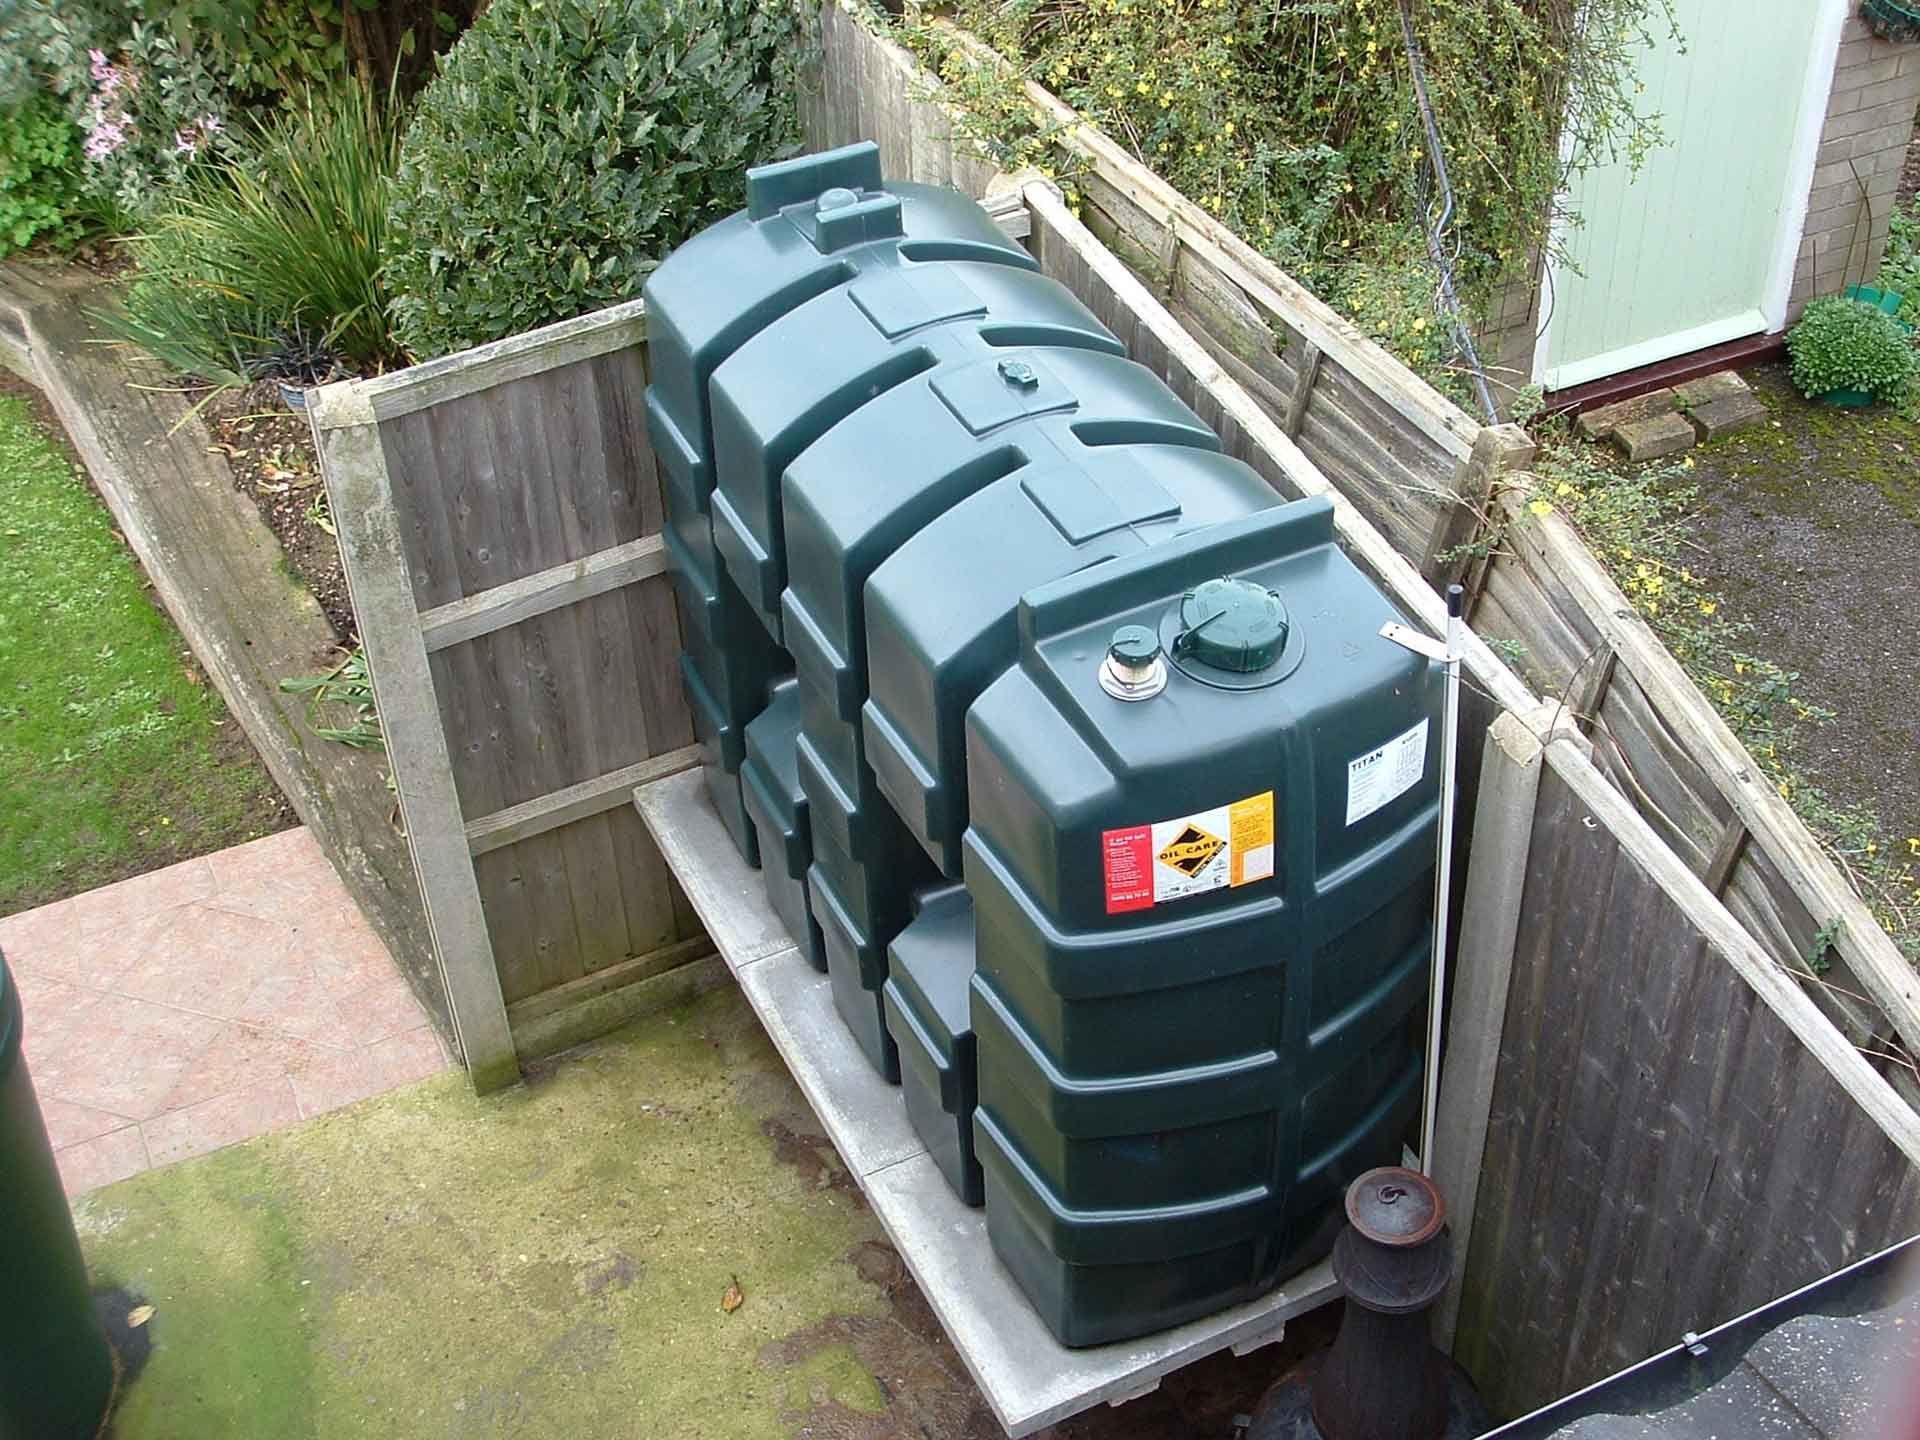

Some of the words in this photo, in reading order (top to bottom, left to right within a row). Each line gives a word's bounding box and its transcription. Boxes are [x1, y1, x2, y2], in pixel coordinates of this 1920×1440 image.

[1351, 750, 1383, 771] TITAN
[1160, 850, 1179, 860] OIL
[1186, 840, 1218, 854] CARE
